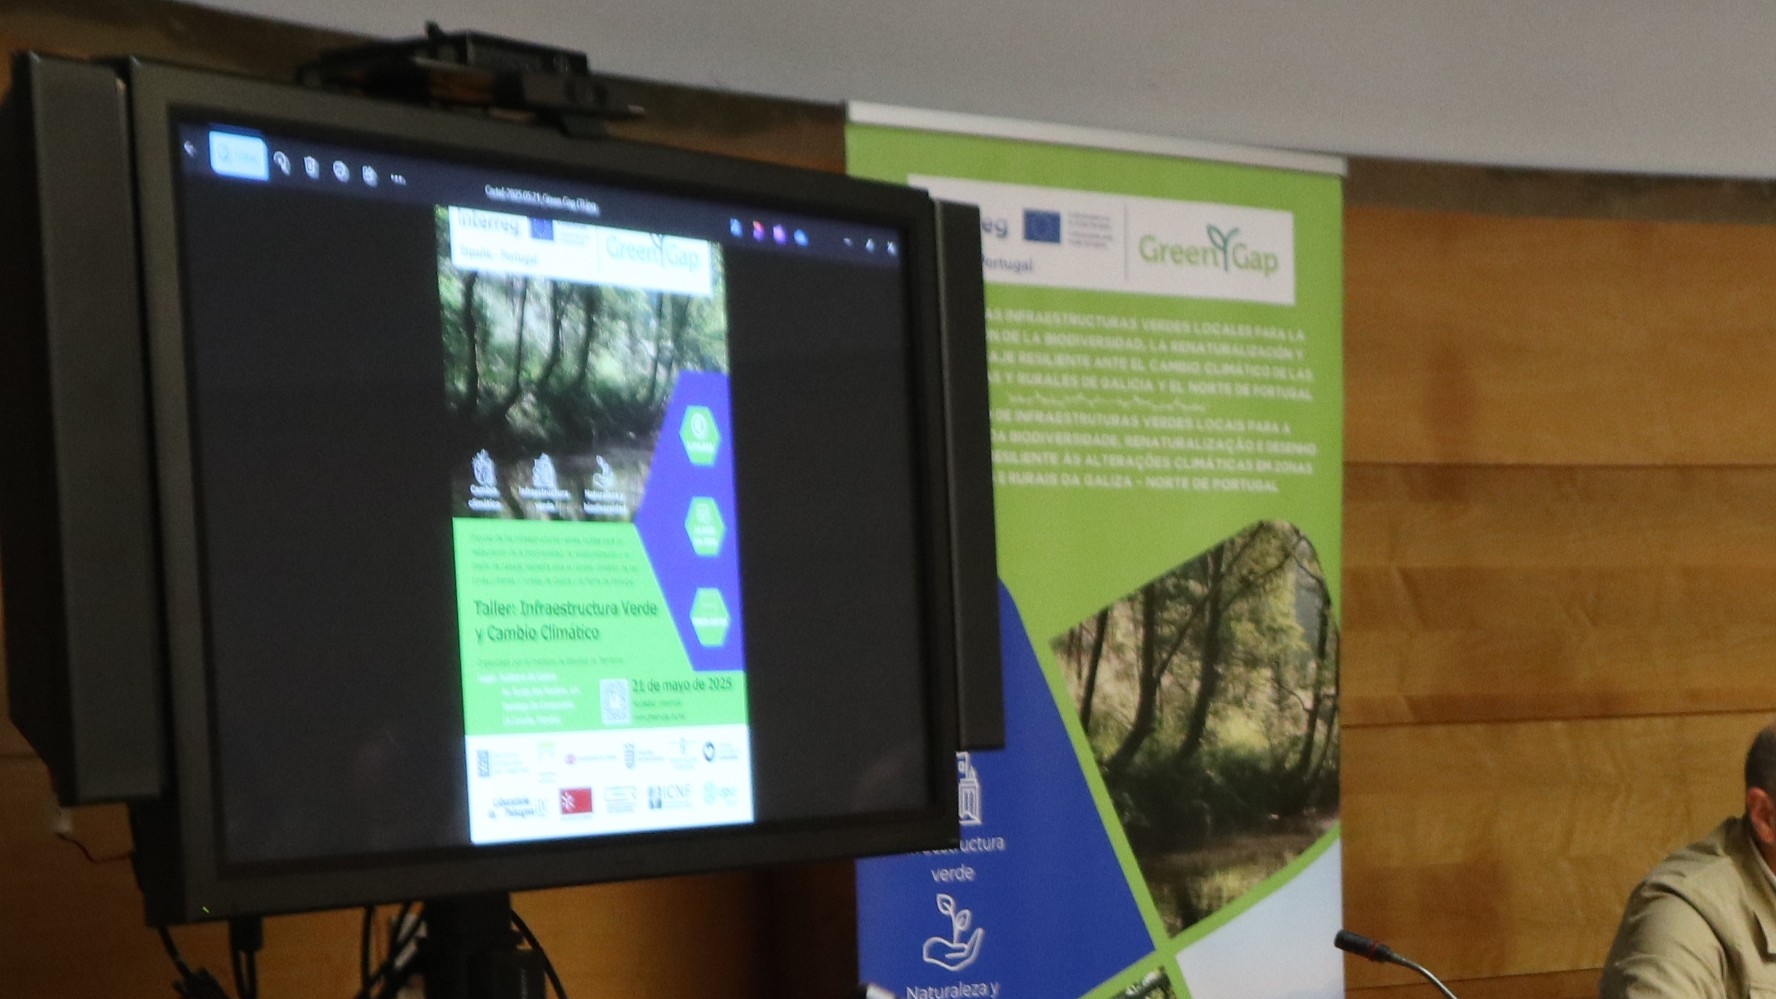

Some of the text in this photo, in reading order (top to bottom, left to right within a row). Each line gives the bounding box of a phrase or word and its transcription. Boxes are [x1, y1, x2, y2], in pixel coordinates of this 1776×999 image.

[606, 236, 699, 270] Green Gap
[1138, 235, 1279, 277] Green Gap
[1004, 309, 1137, 329] INFRAESTRUCTURAS
[1142, 317, 1190, 333] VERDES
[1193, 321, 1252, 337] LOCALES
[1254, 325, 1286, 340] PARA
[1287, 327, 1305, 341] LA
[1002, 329, 1020, 343] DE
[1022, 331, 1041, 345] LA
[1149, 338, 1167, 351] LA
[987, 350, 1014, 364] AJE
[1017, 351, 1090, 368] RESILIENTE
[1094, 355, 1128, 369] ANTE
[1130, 357, 1145, 371] EL
[1149, 358, 1200, 374] CAMBIO
[1272, 365, 1287, 381] DE
[1288, 367, 1314, 383] LAS
[1016, 372, 1078, 388] RURALES
[1080, 375, 1097, 389] DE
[1100, 376, 1153, 392] GALICIA
[1169, 380, 1184, 394] EL
[1187, 381, 1233, 395] NORTE
[1234, 383, 1251, 397] DE
[1142, 415, 1193, 430] VERDES
[1196, 417, 1245, 433] LOCAIS
[1248, 419, 1279, 433] PARA
[1282, 421, 1292, 434] A
[991, 449, 1059, 465] ESILIENTE
[1273, 460, 1313, 475] ZONAS
[1008, 471, 1057, 485] RURAIS
[1060, 473, 1081, 486] DA
[1084, 474, 1132, 489] GALIZA
[1145, 475, 1189, 489] NORTE
[1191, 477, 1209, 491] DE
[1212, 477, 1279, 493] PORTUGAL
[474, 599, 658, 618] Taller: Infraestructura Verde
[474, 622, 600, 643] y Cambio Climático
[632, 676, 733, 694] 21 de mayo de 2025
[931, 864, 975, 882] verde
[989, 982, 1000, 999] y
